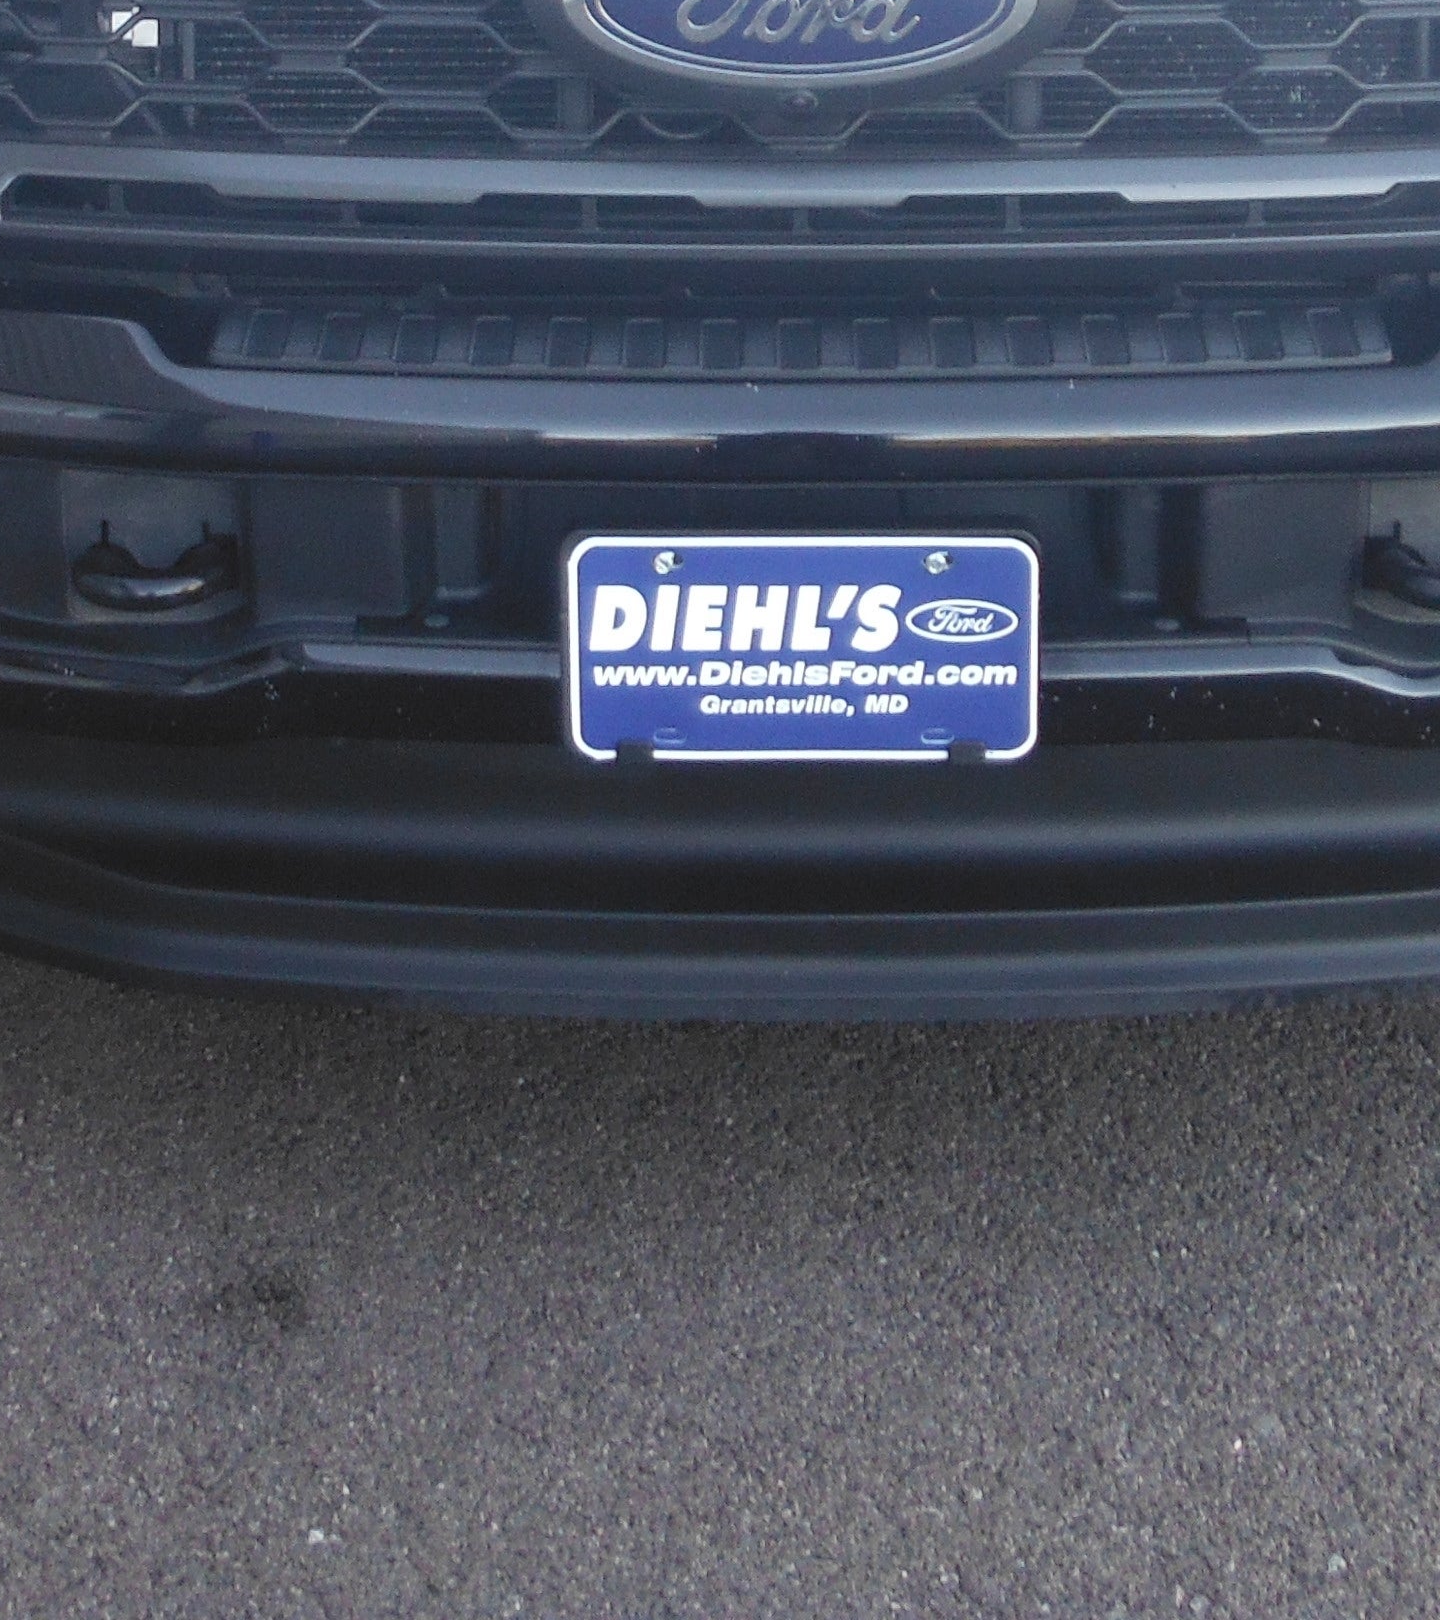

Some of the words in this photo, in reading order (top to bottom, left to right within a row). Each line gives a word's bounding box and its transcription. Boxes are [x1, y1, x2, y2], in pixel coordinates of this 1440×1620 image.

[588, 583, 902, 652] DIEHL'S
[926, 603, 994, 635] Ford
[593, 660, 1017, 687] www.DiehlsFord.com
[699, 694, 856, 718] Grantsville,
[864, 694, 910, 715] MD
